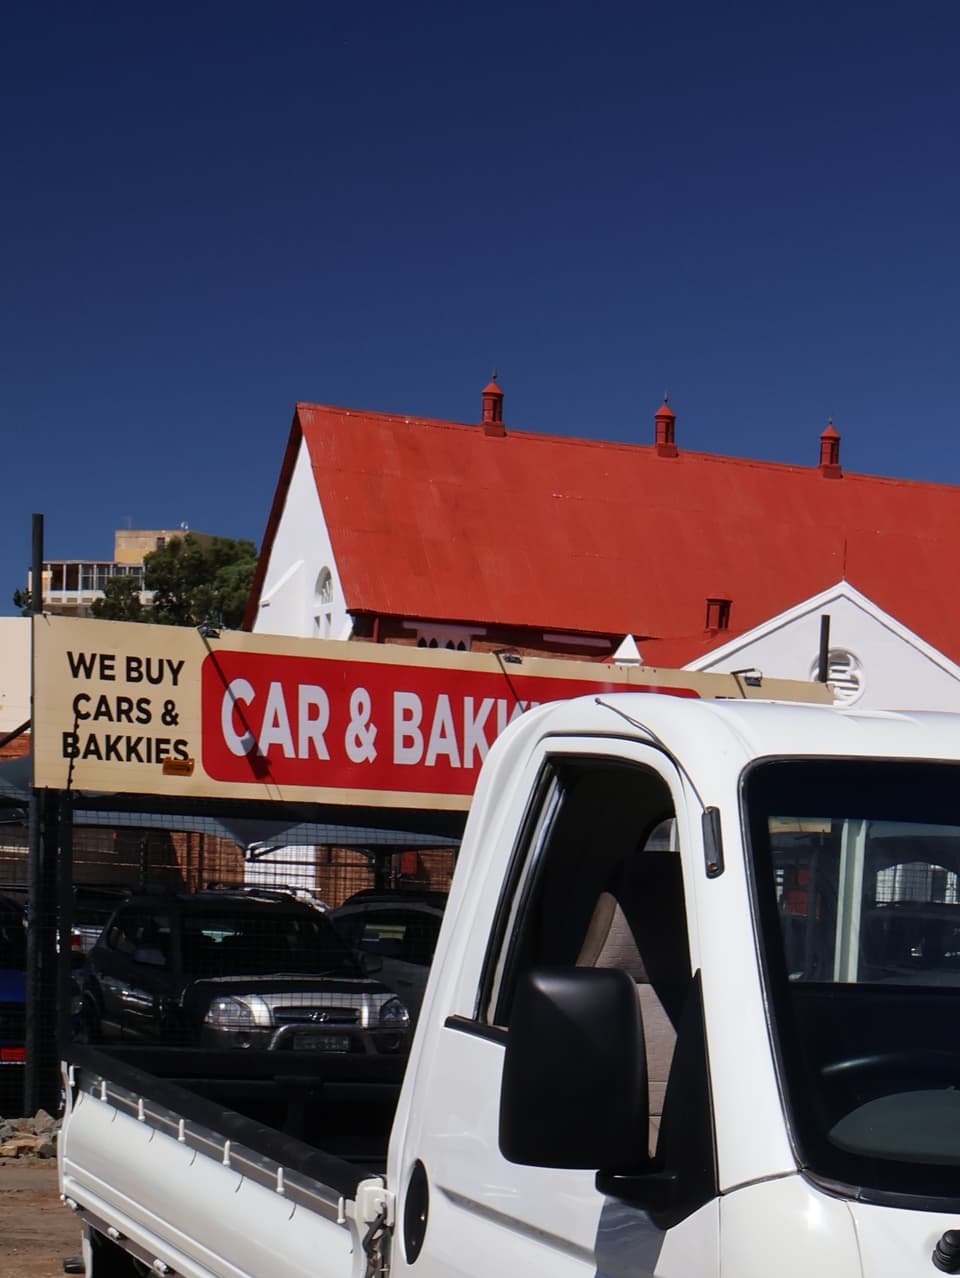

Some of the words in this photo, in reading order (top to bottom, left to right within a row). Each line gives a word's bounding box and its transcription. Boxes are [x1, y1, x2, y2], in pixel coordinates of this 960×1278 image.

[67, 651, 116, 681] WE
[126, 656, 185, 686] BUY
[73, 693, 152, 725] CARS
[161, 700, 179, 727] &
[221, 678, 330, 761] CAR
[344, 687, 378, 764] &
[63, 732, 189, 764] BAKKIES
